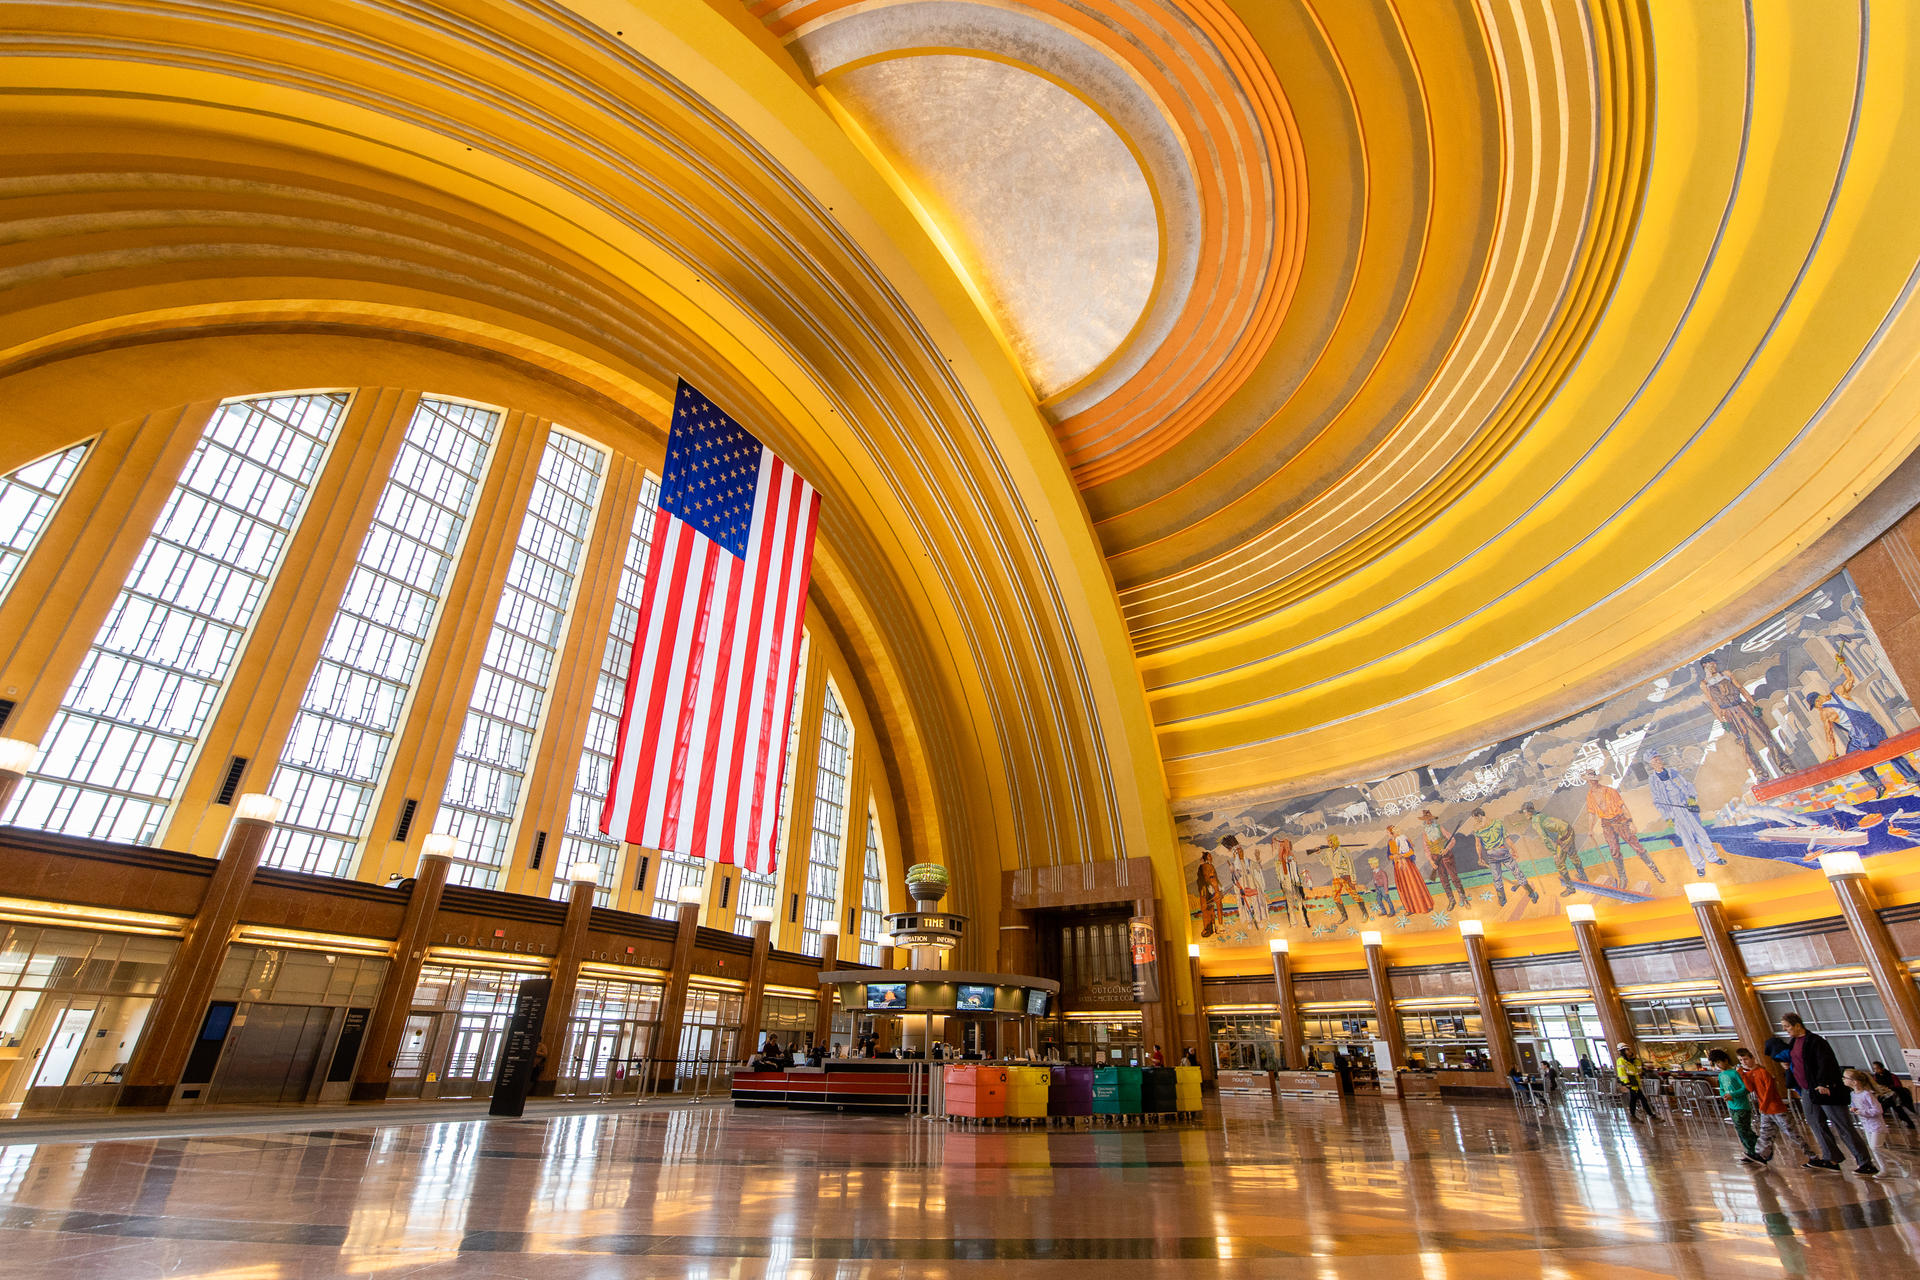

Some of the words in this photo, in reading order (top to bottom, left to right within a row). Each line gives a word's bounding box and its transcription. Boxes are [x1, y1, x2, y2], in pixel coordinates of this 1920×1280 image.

[923, 918, 944, 928] TIME
[444, 933, 468, 946] TO
[475, 937, 547, 954] STREET
[591, 949, 608, 961] TO
[613, 953, 665, 968] STREET
[1091, 986, 1132, 994] OUTGOING
